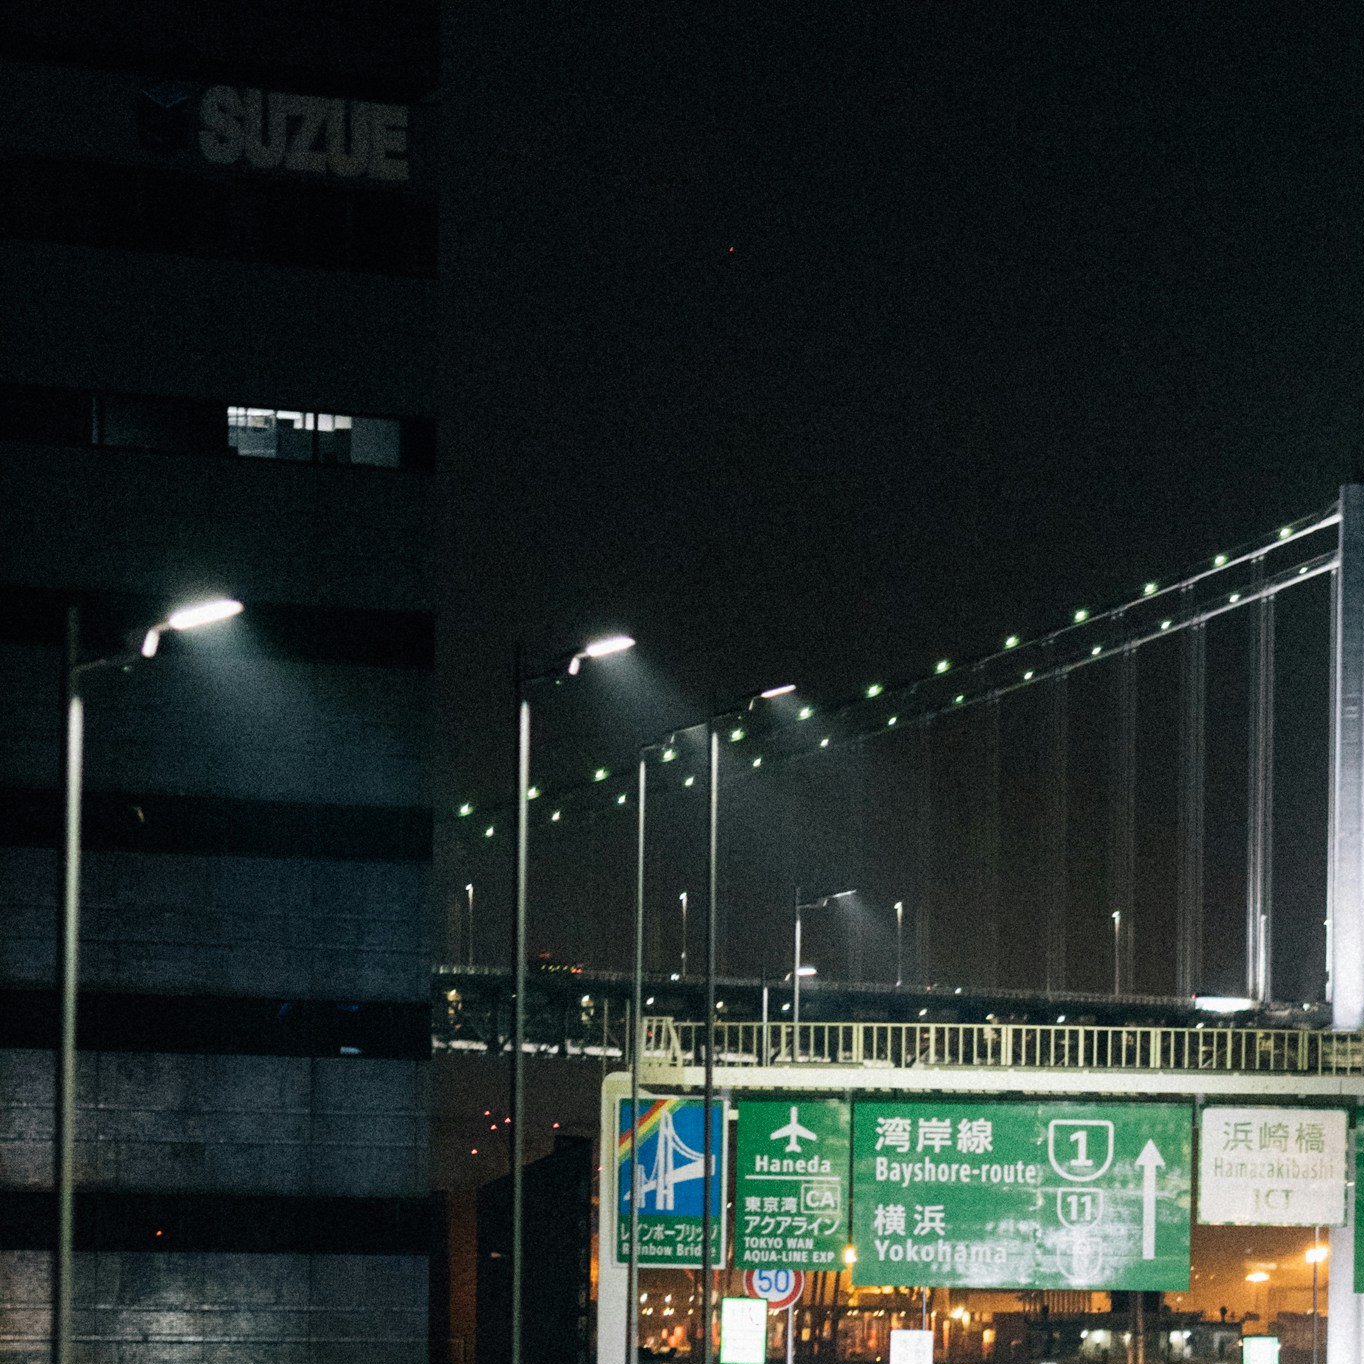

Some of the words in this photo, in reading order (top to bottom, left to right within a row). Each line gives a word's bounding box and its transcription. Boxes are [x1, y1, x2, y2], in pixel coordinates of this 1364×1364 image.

[199, 85, 409, 180] SUZUE
[875, 1117, 993, 1153] 湾岸線
[1223, 1121, 1326, 1154] 浜崎橋
[1070, 1131, 1093, 1167] 1
[755, 1155, 831, 1173] Haneda
[875, 1156, 1036, 1188] Bayshore-route
[1214, 1157, 1334, 1180] Hamazakibashi
[745, 1196, 797, 1213] 東京湾
[806, 1190, 835, 1208] CA
[1067, 1195, 1092, 1221] 11
[1253, 1188, 1294, 1212] JCT
[744, 1216, 840, 1236] アクアライン
[874, 1204, 946, 1236] 横浜
[677, 1243, 716, 1258] Bride
[744, 1236, 783, 1249] TOKYO
[787, 1238, 814, 1250] WAN
[874, 1238, 1007, 1263] Yokohama
[743, 1250, 809, 1263] AQUA-LINE
[812, 1251, 836, 1263] EXP
[758, 1268, 789, 1293] 50
